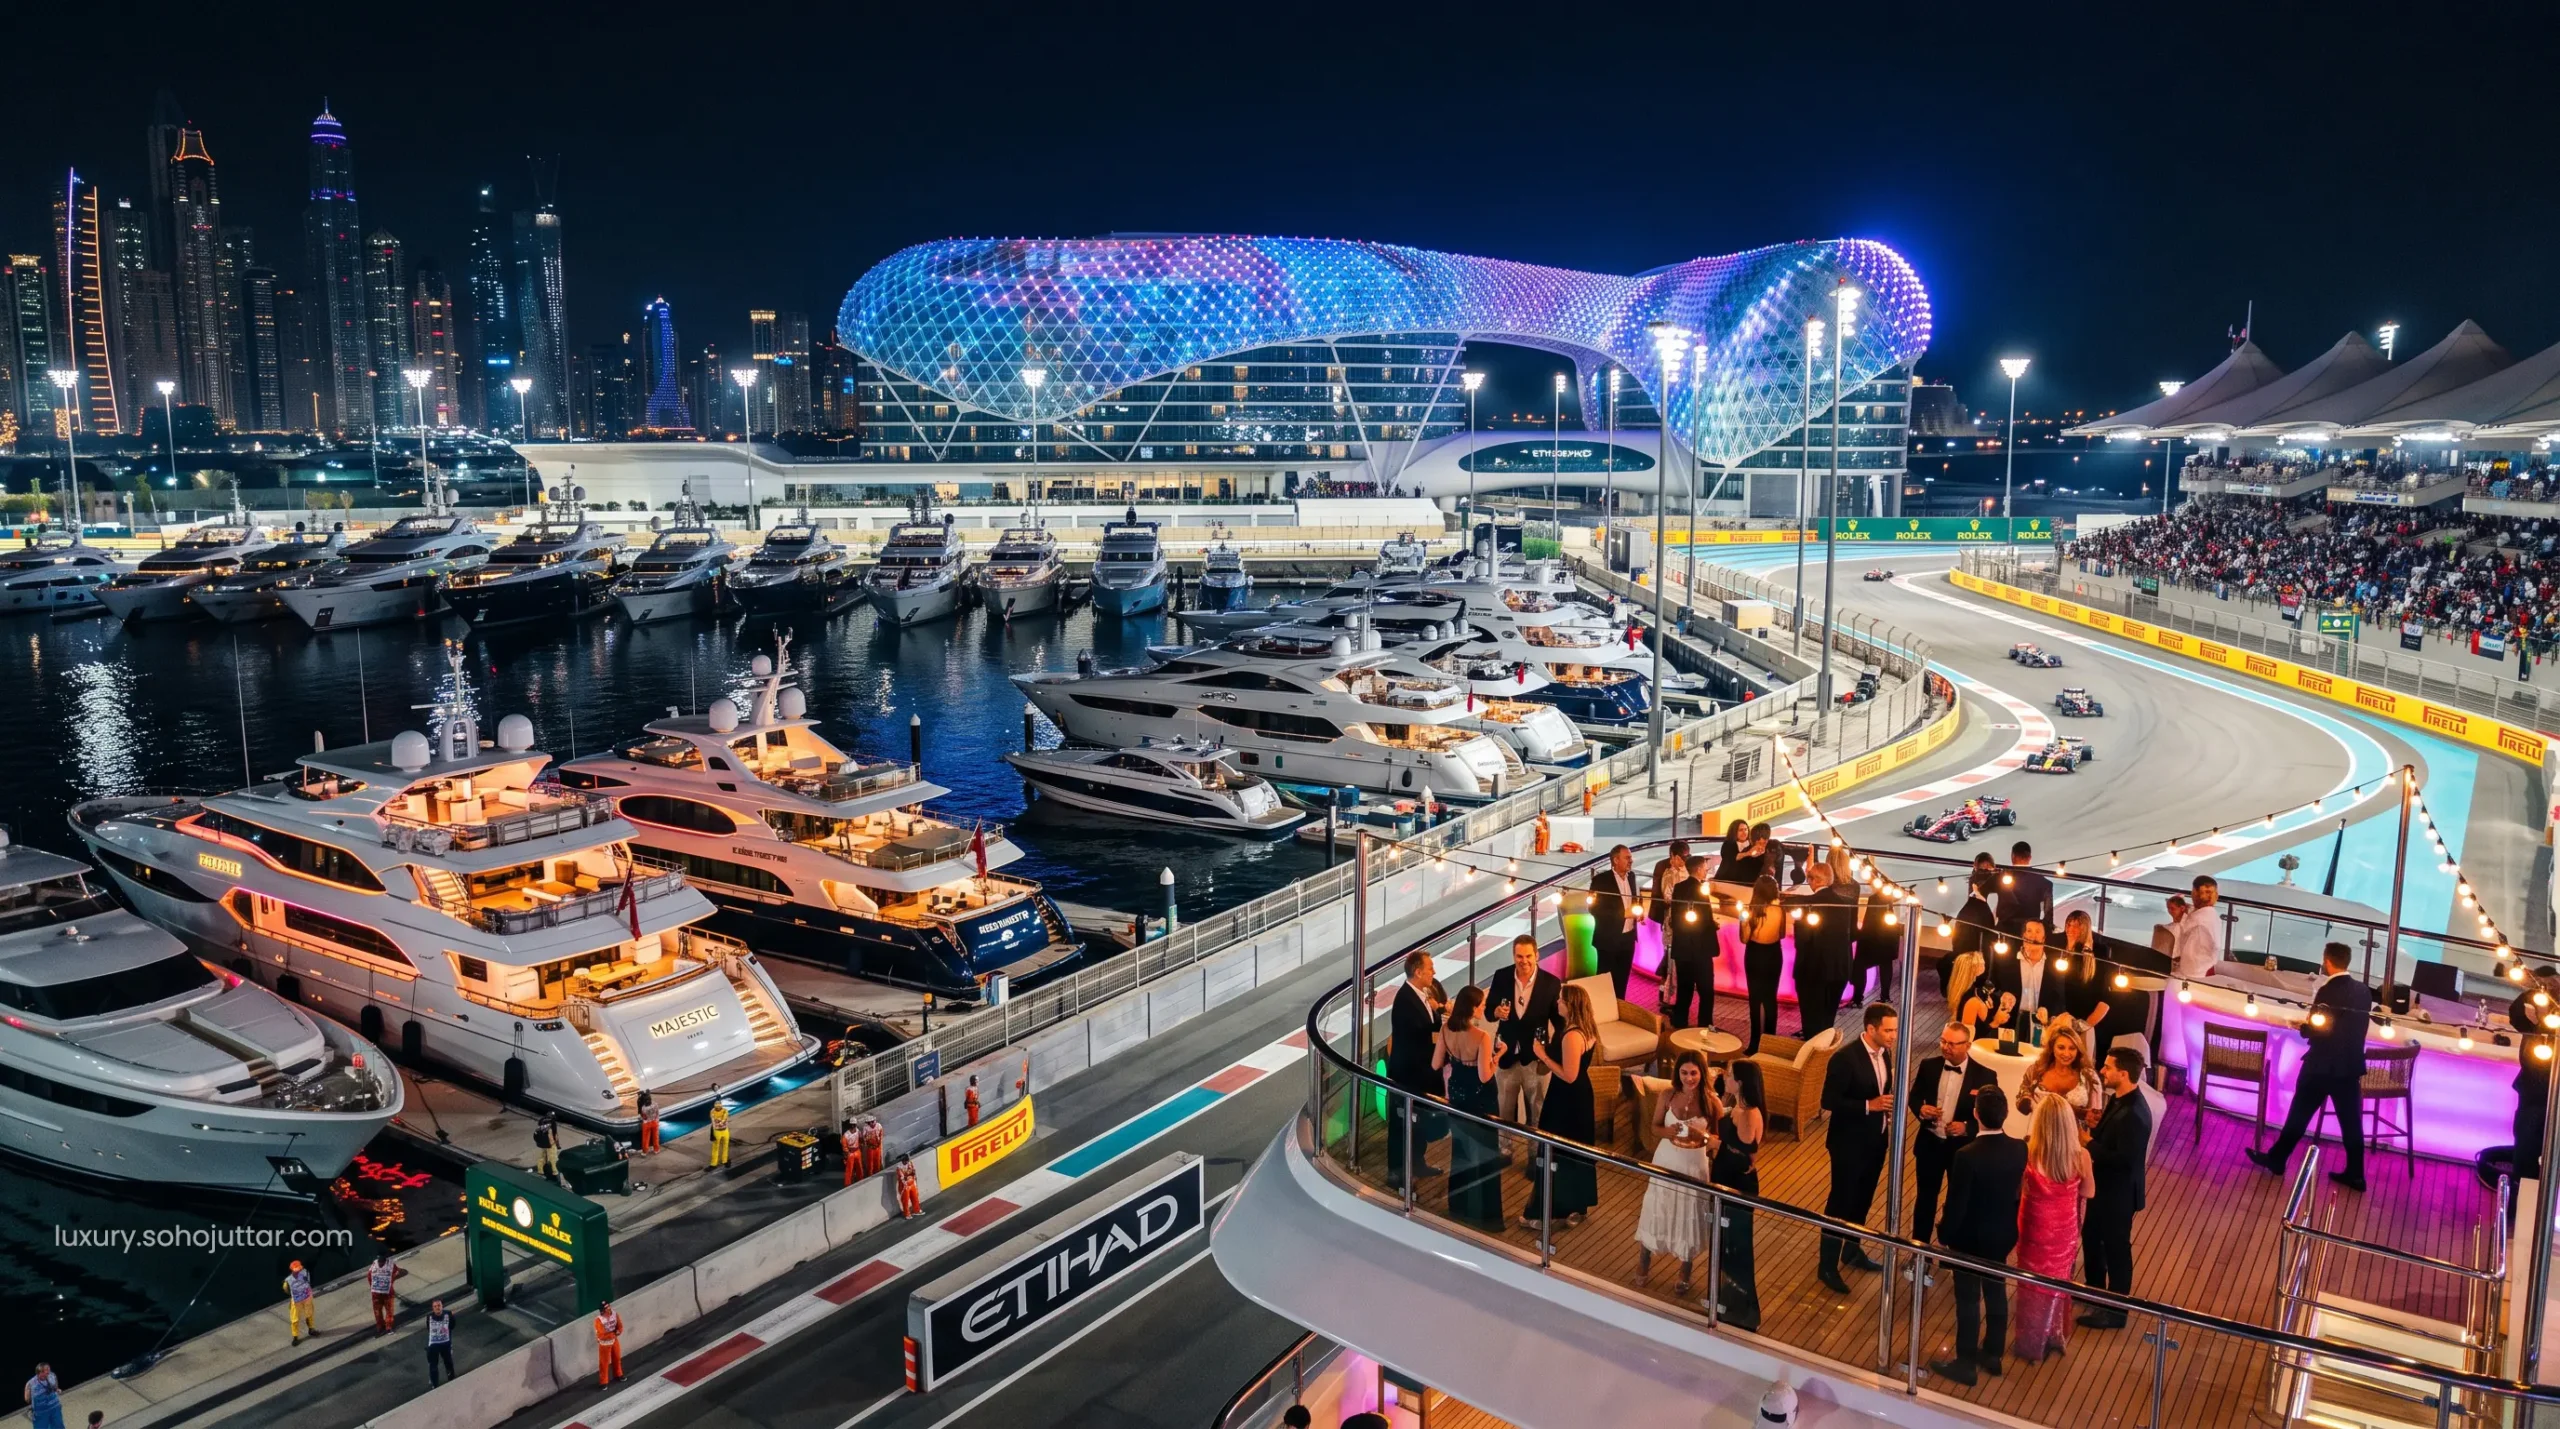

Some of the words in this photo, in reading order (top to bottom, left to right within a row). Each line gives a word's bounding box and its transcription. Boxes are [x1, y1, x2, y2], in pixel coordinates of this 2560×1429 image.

[1835, 532, 1870, 540] ROLEX
[1896, 532, 1931, 540] ROLEX
[2356, 686, 2396, 714] PIRELLI
[2422, 705, 2467, 735] PIRELLI
[2498, 727, 2543, 761] PIRELLI
[1747, 791, 1785, 820] PIRELLI
[651, 1005, 719, 1038] MAJESTIC
[950, 1108, 1027, 1174] PIRELLI
[961, 1194, 1179, 1342] ETIHAD
